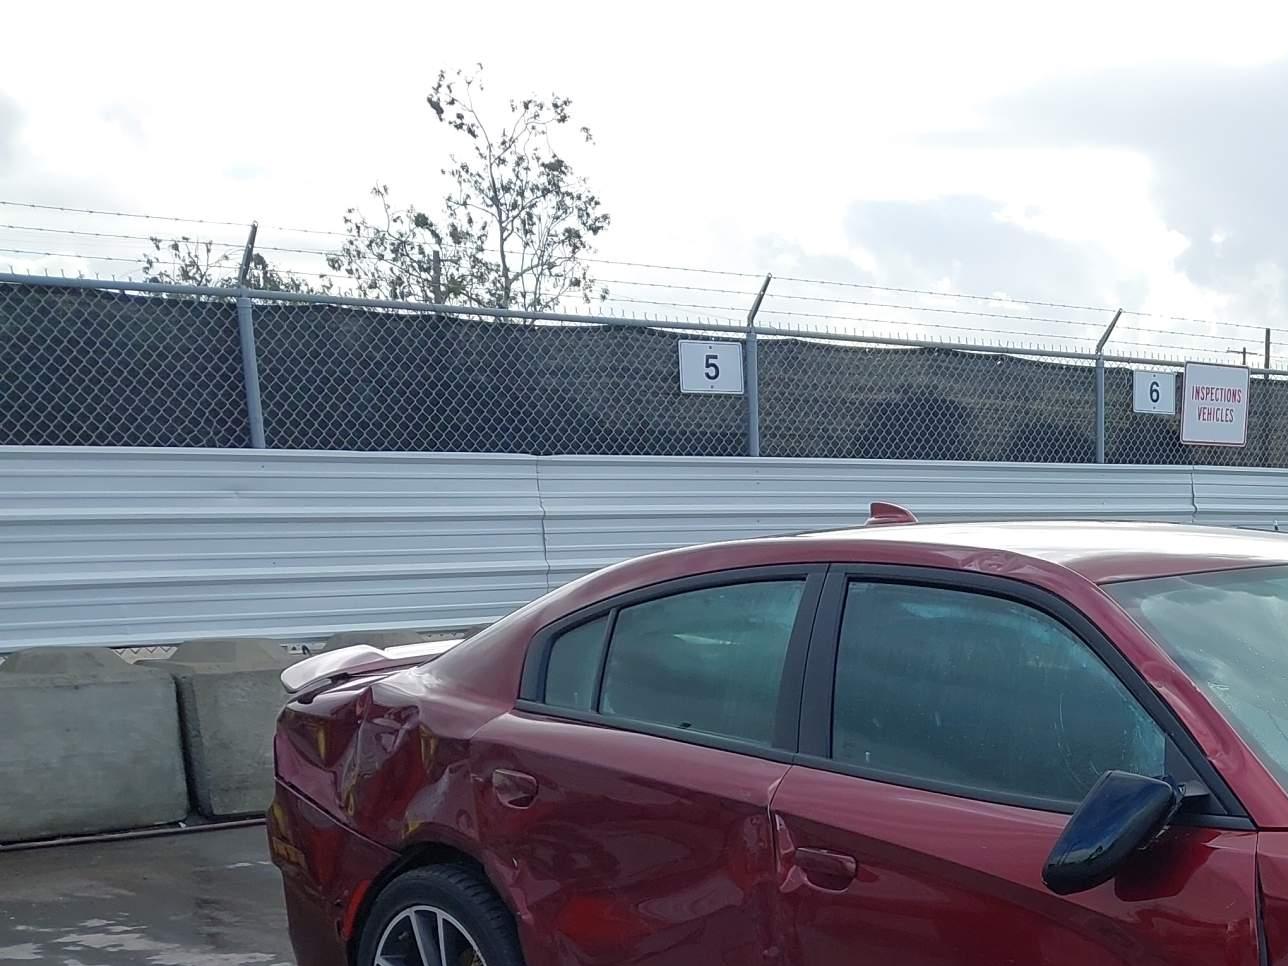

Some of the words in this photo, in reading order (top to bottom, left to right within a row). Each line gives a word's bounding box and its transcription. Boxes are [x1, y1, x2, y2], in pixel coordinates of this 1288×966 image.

[704, 354, 720, 381] 5
[1149, 381, 1161, 403] 6
[1191, 385, 1242, 403] INSPECTIONS
[1197, 406, 1234, 423] VEHICLES
